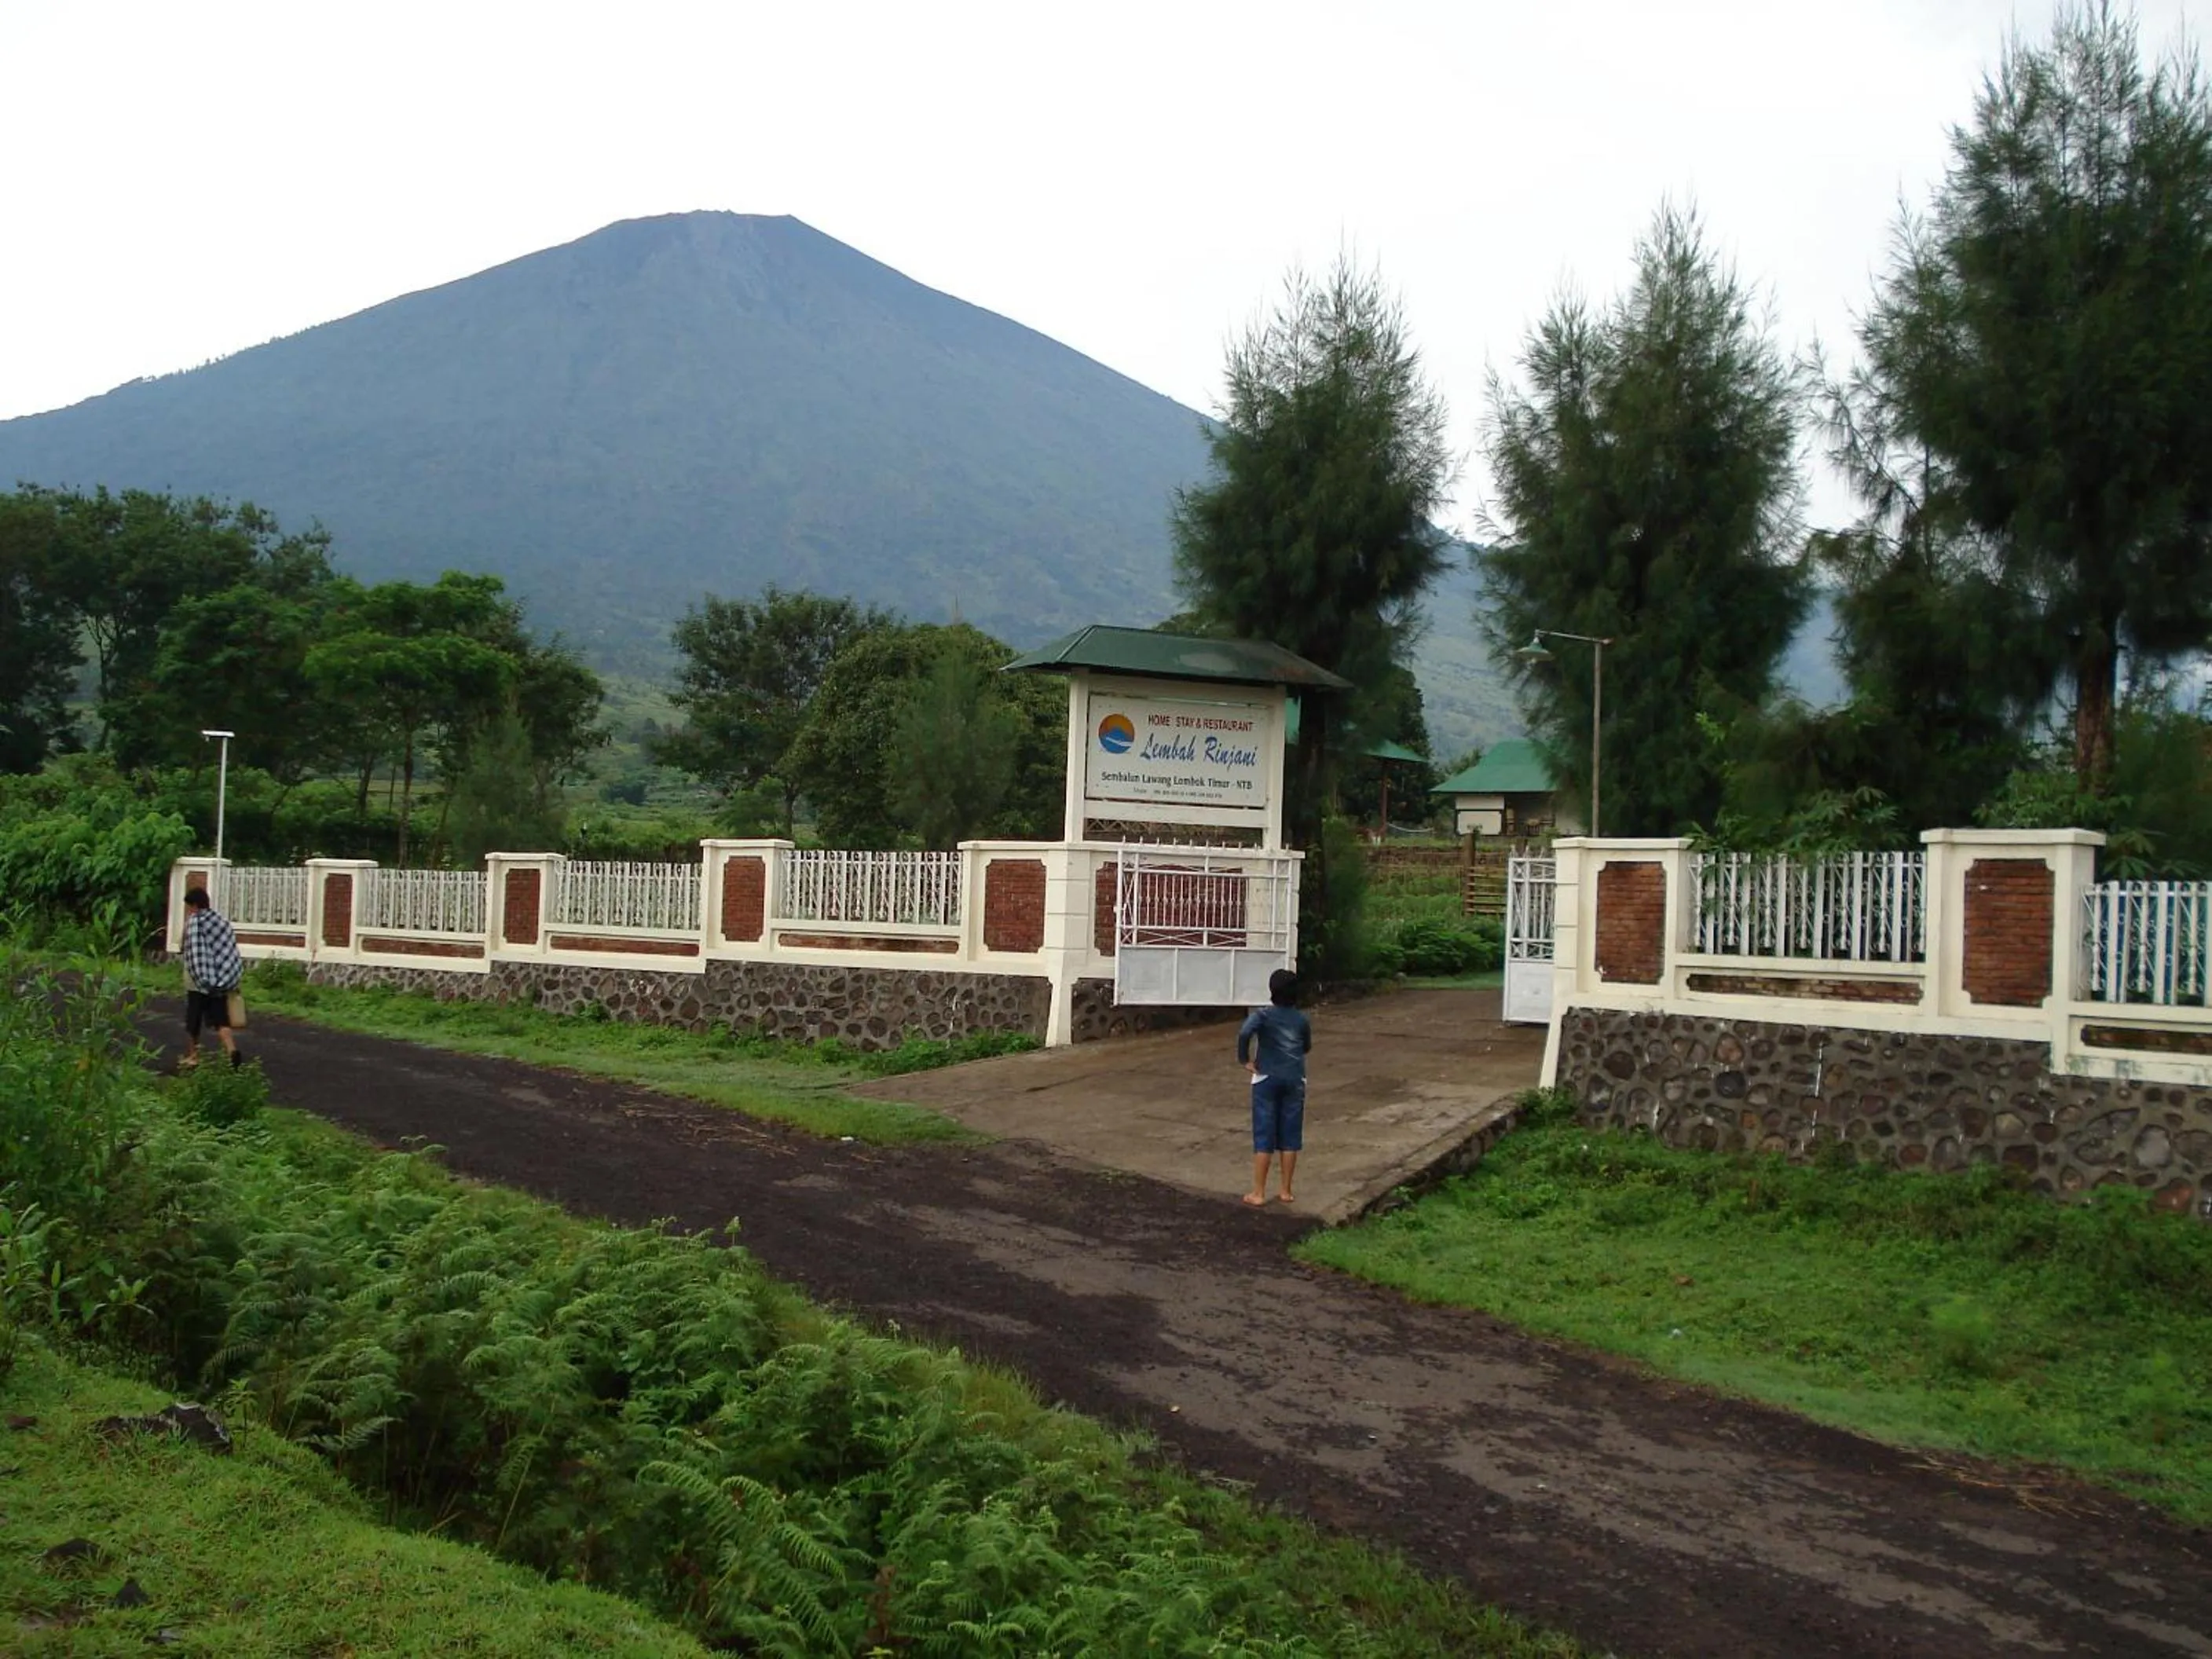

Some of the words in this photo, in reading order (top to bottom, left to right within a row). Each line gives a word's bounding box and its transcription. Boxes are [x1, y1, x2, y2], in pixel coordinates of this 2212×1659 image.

[1148, 714, 1170, 727] HOME
[1175, 716, 1195, 728] STAY
[1203, 719, 1254, 732] RESTAURANT
[1140, 732, 1196, 762] Lembah
[1203, 734, 1258, 771] Rinjani
[1101, 771, 1140, 783] Sembalun
[1142, 773, 1172, 786] Lawang
[1174, 775, 1204, 787] Lombok
